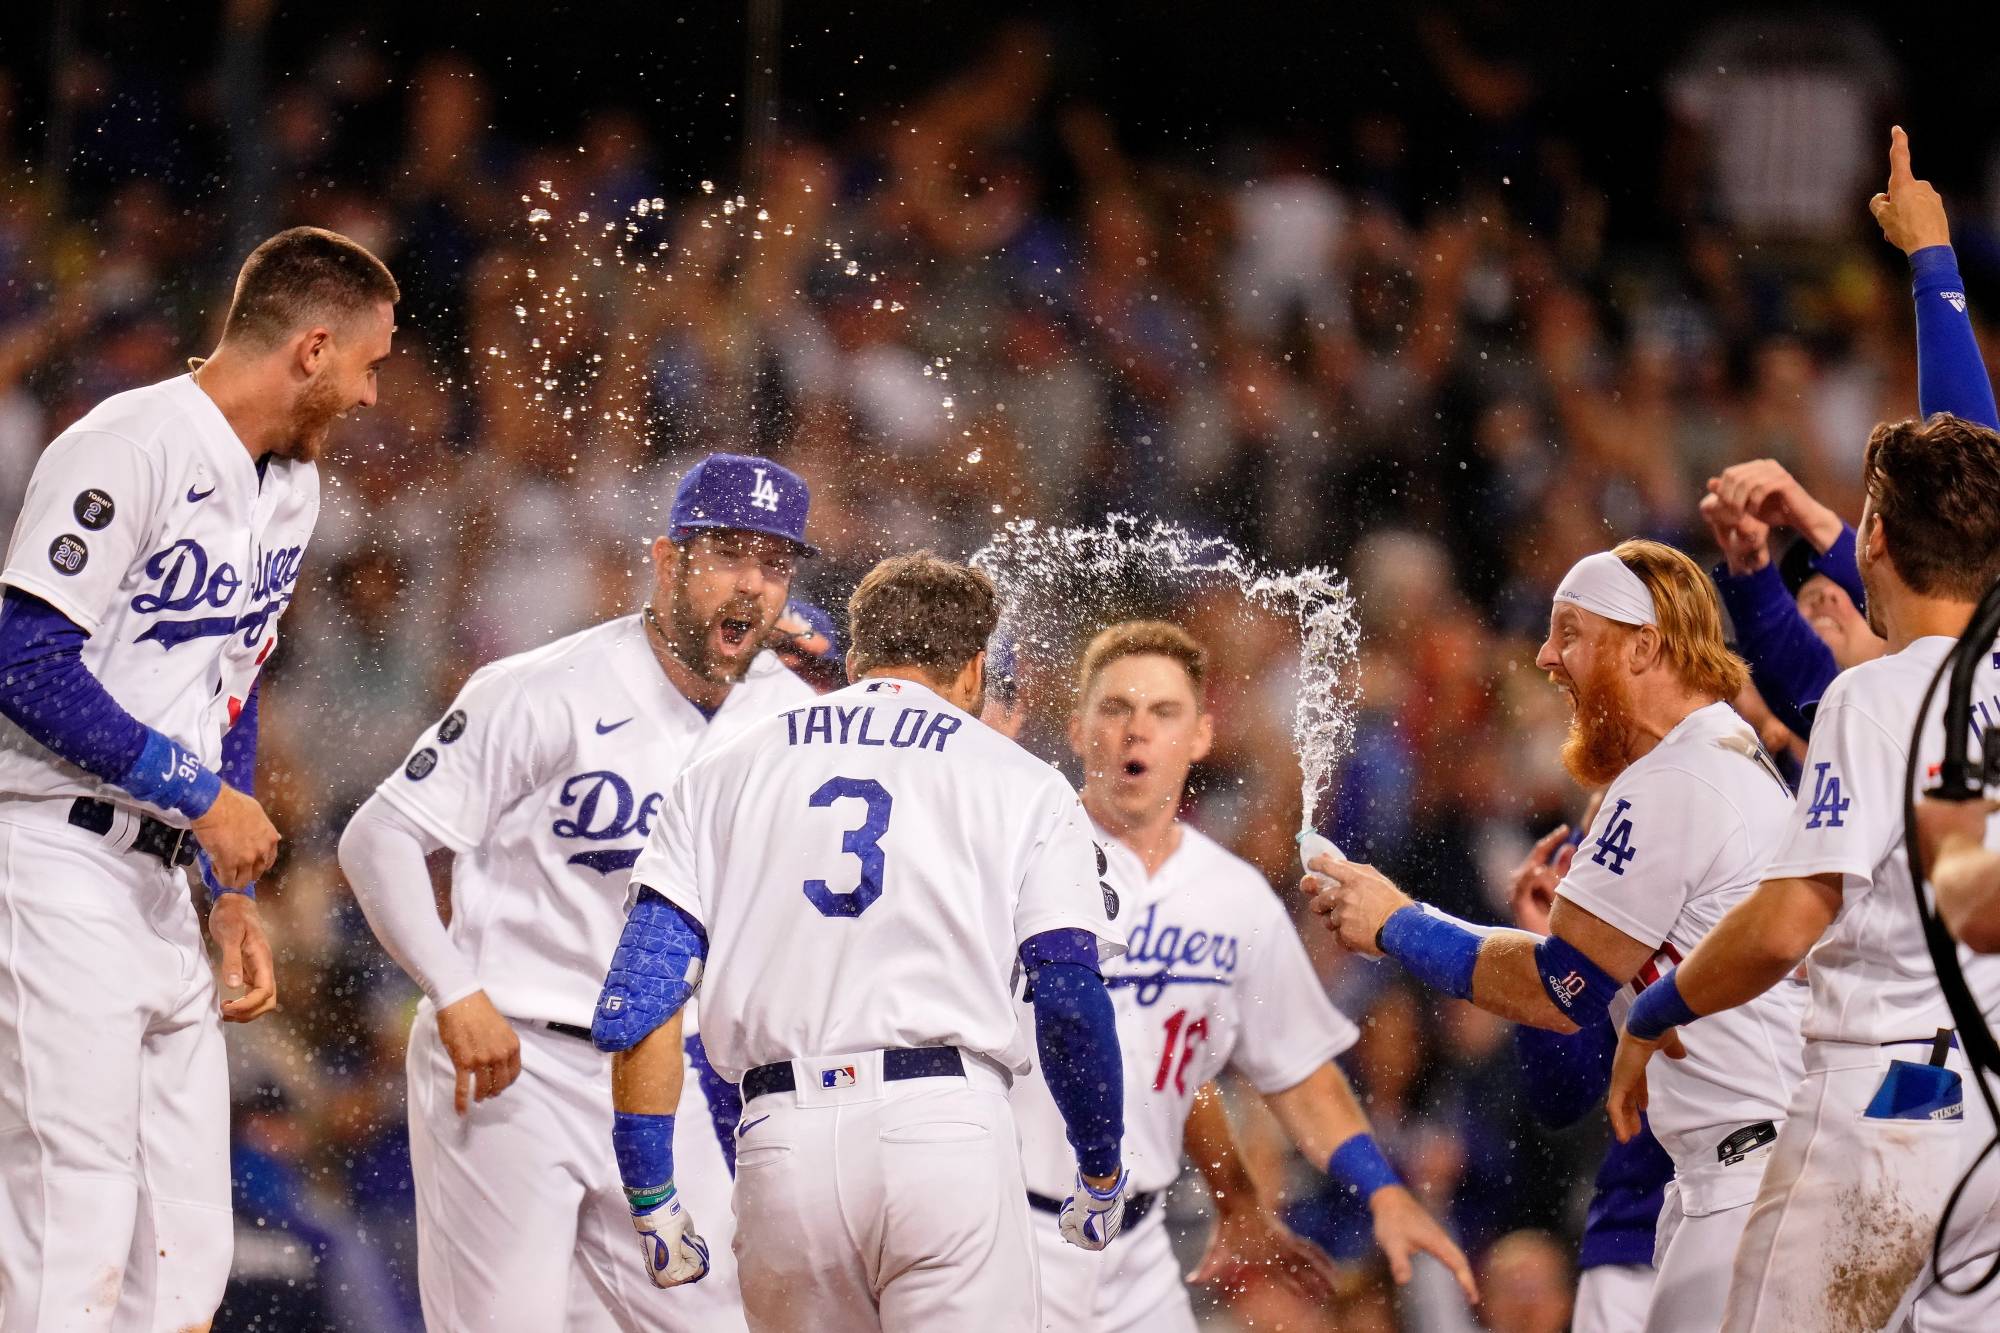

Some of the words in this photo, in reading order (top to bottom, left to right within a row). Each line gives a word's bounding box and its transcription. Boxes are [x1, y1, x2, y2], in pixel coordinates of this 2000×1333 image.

[88, 491, 112, 509] TOMMY
[751, 468, 779, 512] LA
[83, 501, 102, 523] 2
[53, 544, 82, 570] 20
[61, 536, 86, 555] SUTTON
[778, 705, 963, 753] TAYLOR
[178, 752, 200, 784] 35
[1806, 761, 1851, 830] LA
[803, 775, 893, 918] 3
[1591, 798, 1637, 876] LA
[1125, 901, 1238, 1007] dgers
[1549, 975, 1573, 1008] adidas
[1561, 970, 1586, 996] 10
